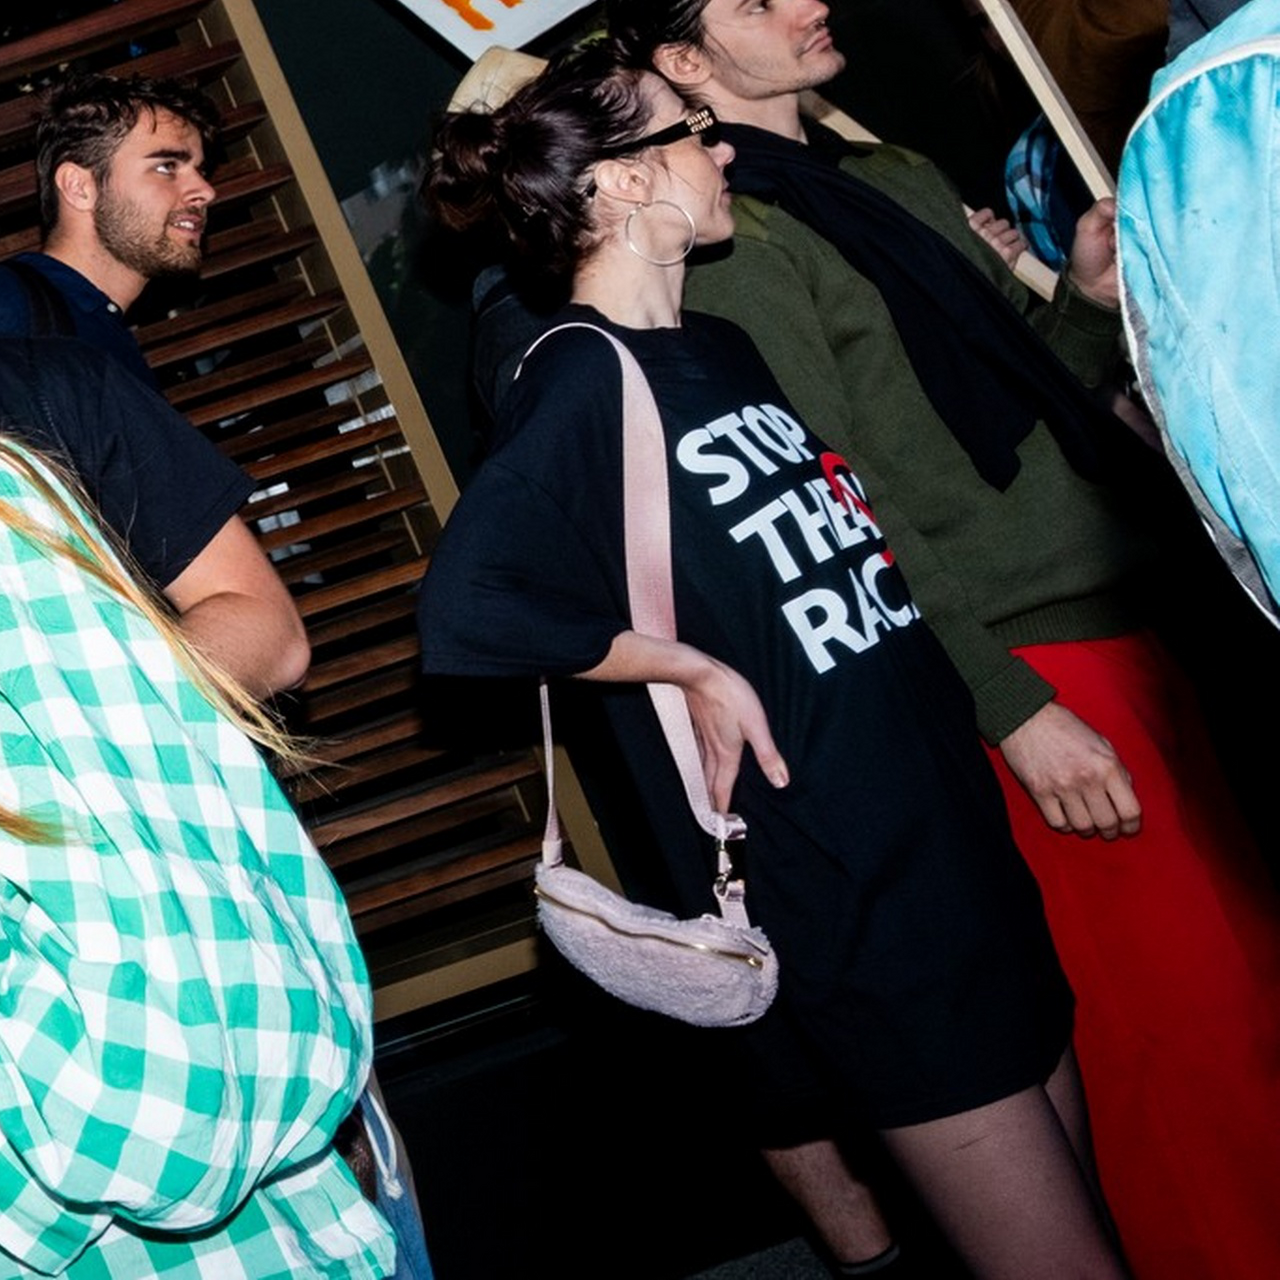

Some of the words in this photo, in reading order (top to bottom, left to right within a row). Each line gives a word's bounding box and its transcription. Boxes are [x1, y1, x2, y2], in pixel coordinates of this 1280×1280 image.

[676, 403, 816, 507] STOP
[728, 476, 867, 584] THE
[781, 551, 921, 675] RAC
